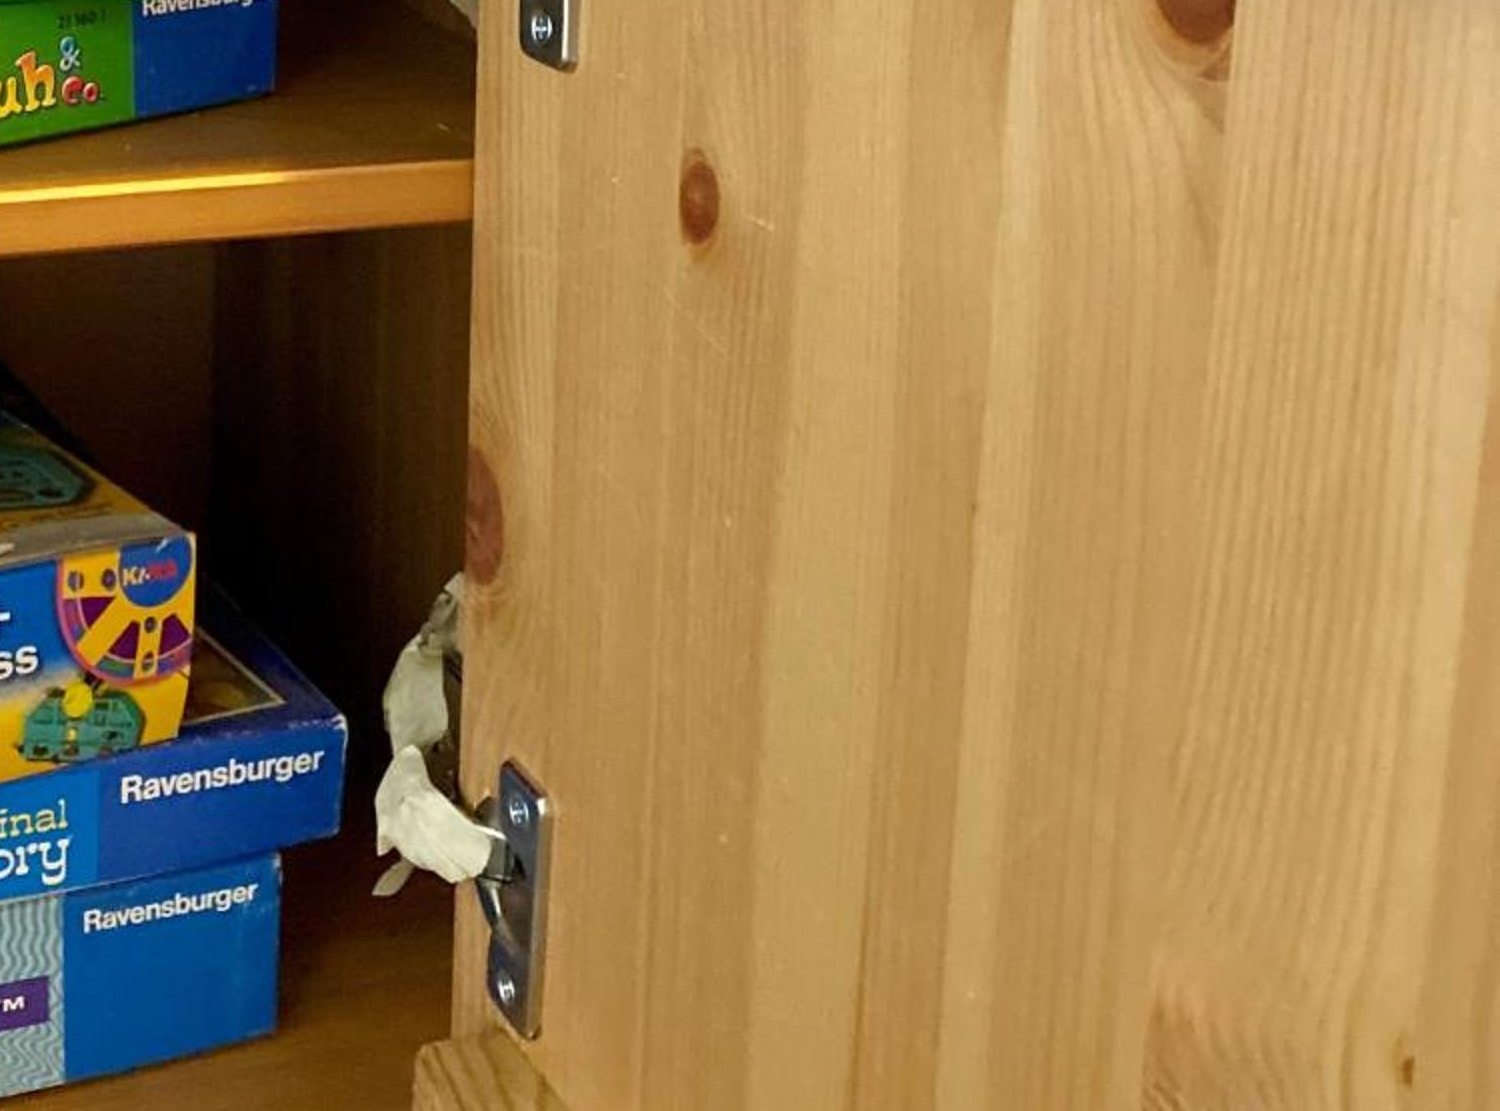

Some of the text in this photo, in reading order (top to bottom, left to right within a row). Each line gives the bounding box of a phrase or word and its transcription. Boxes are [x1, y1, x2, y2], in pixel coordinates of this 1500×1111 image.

[58, 35, 81, 72] &
[119, 750, 325, 804] Ravensburger
[82, 883, 259, 934] Ravensburger
